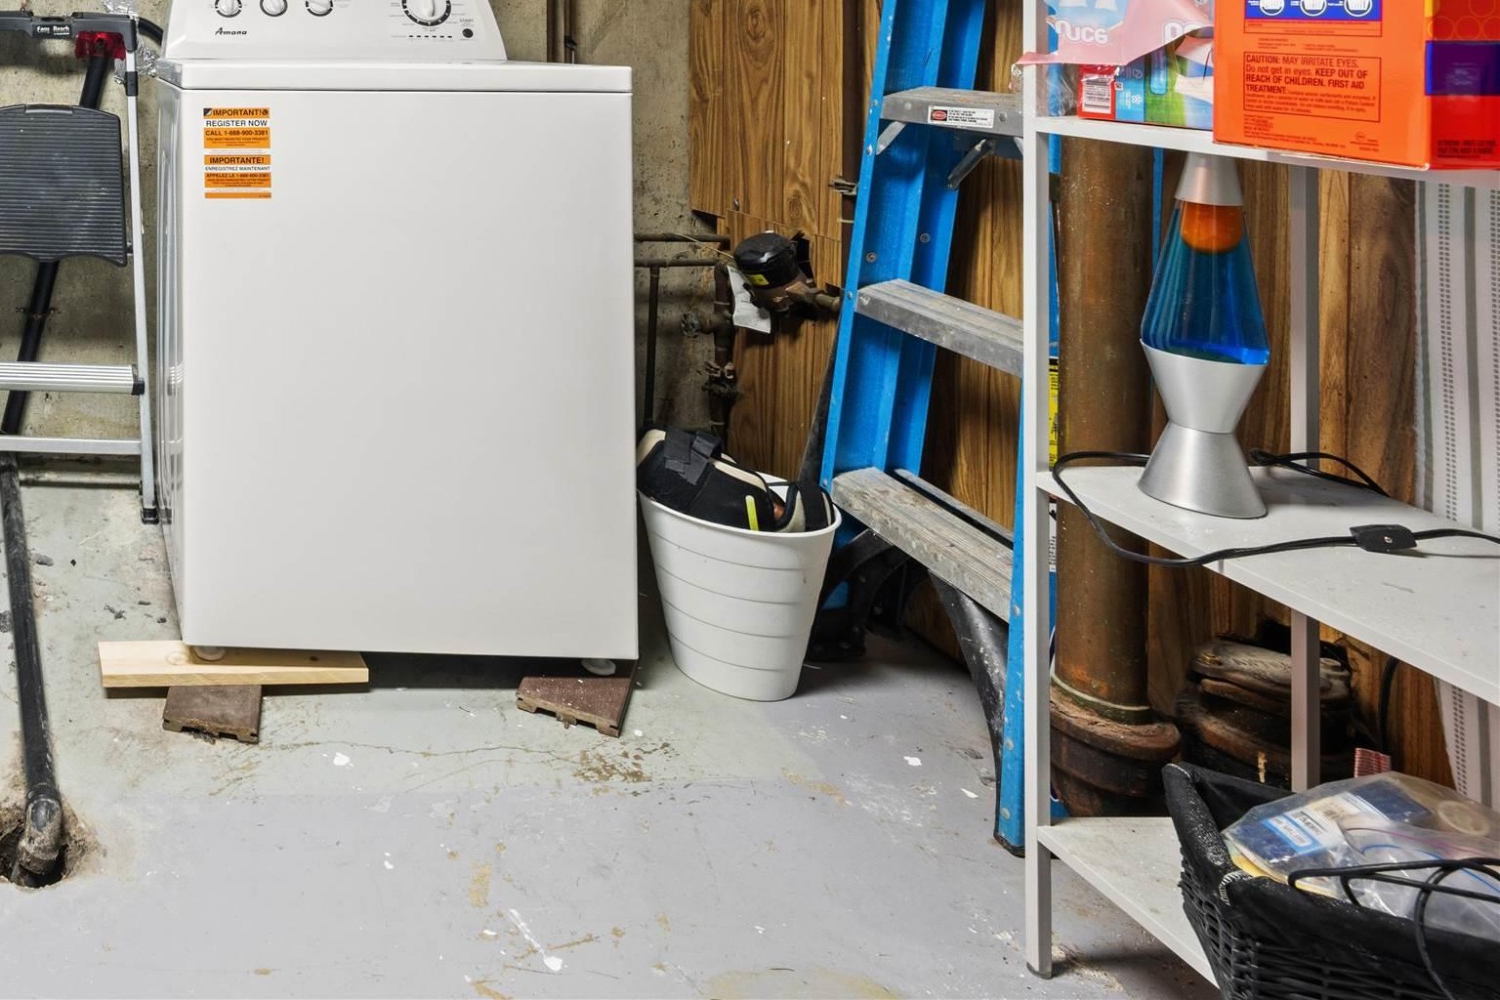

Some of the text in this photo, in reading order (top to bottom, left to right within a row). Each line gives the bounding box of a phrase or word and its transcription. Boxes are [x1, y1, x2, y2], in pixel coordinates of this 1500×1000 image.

[214, 27, 248, 36] Amana
[1246, 55, 1359, 68] CAUTION: MAY IRRITATE EYES.
[1270, 67, 1283, 75] get
[1293, 68, 1312, 77] eyes.
[1315, 68, 1335, 77] KEEP
[1338, 69, 1354, 78] OUT
[1357, 70, 1368, 79] OF
[1246, 74, 1365, 89] REACH OF CHILDREN. FIRST AID
[1246, 84, 1287, 94] TREATMENT:
